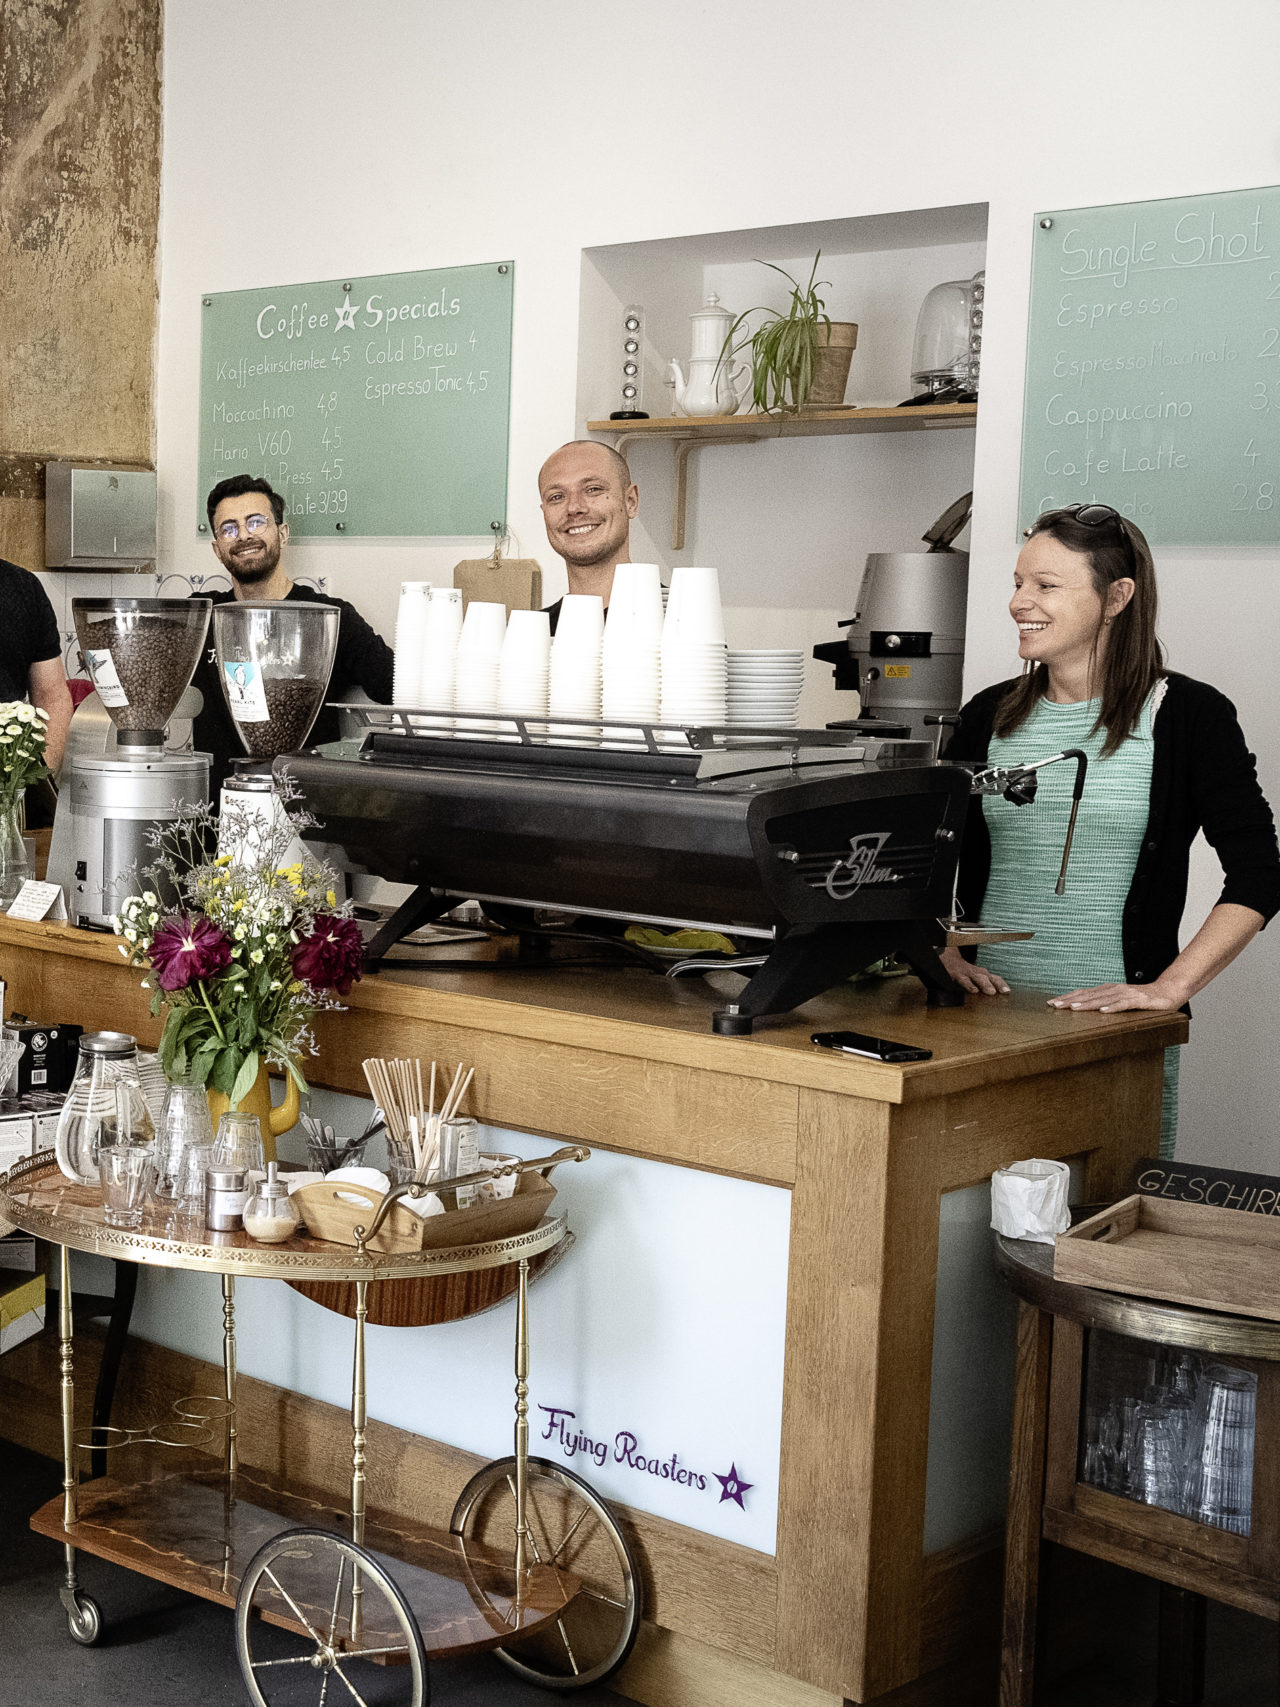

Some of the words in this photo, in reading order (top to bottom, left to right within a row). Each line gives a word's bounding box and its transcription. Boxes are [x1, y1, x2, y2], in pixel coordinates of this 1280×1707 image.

[1059, 222, 1158, 288] Single
[1171, 205, 1265, 265] Shot
[256, 303, 329, 340] Coffee
[363, 288, 461, 334] Specials
[1056, 292, 1179, 329] Espresso
[216, 349, 327, 389] Kaffeekirschentee
[331, 345, 351, 368] 4,5
[365, 338, 405, 365] Cold
[412, 335, 458, 361] Brew
[469, 330, 478, 352] 4
[364, 376, 431, 407] Espresso
[428, 364, 463, 392] Tonic
[466, 370, 489, 394] 4,5
[1053, 350, 1148, 386] Espresso
[317, 391, 337, 419] 4,8
[1046, 391, 1193, 440] Cappuccino
[213, 438, 248, 461] Hario
[258, 430, 291, 456] V60
[321, 426, 342, 453] 4,5
[1044, 449, 1110, 486] Cafe
[1122, 443, 1190, 473] Latte
[1242, 439, 1261, 466] 4
[279, 462, 312, 485] Press
[320, 459, 344, 482] 4,5
[1230, 482, 1274, 515] 2,8
[537, 1402, 608, 1467] Flying
[613, 1430, 708, 1491] Roasters
